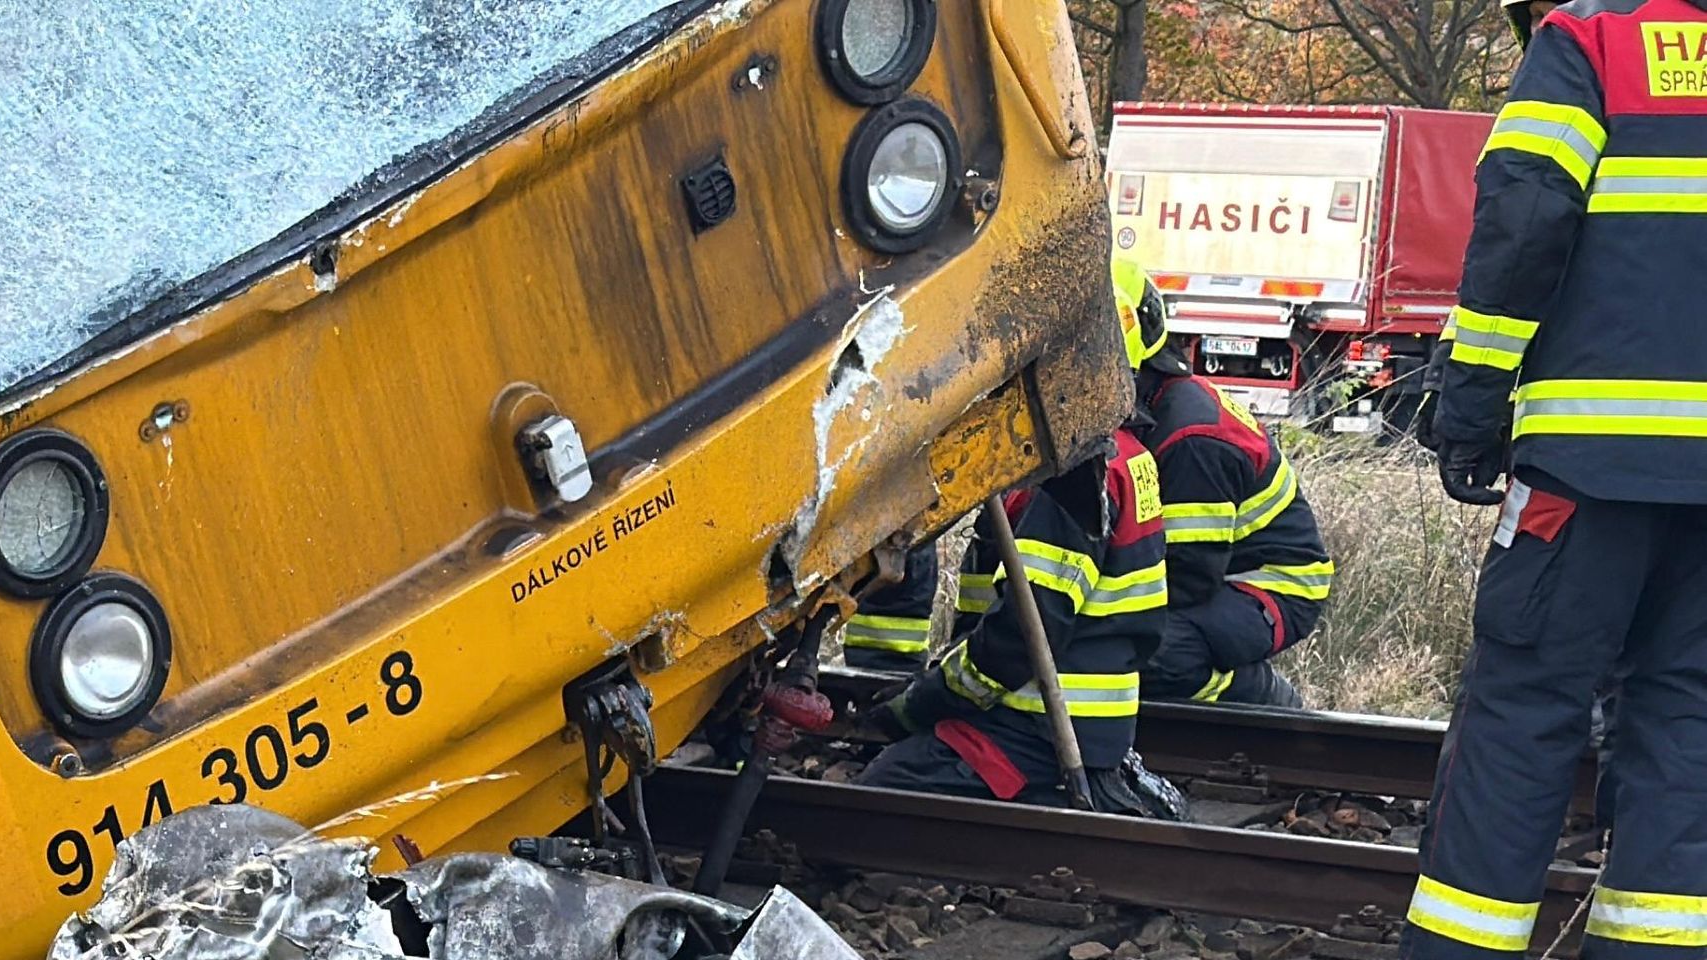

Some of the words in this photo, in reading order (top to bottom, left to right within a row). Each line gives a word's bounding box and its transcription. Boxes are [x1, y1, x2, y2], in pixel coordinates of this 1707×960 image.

[1158, 197, 1310, 234] HASIČI
[510, 524, 608, 603] DÁLKOVÉ
[612, 480, 677, 541] ŘÍZENÍ
[201, 697, 331, 806] 305
